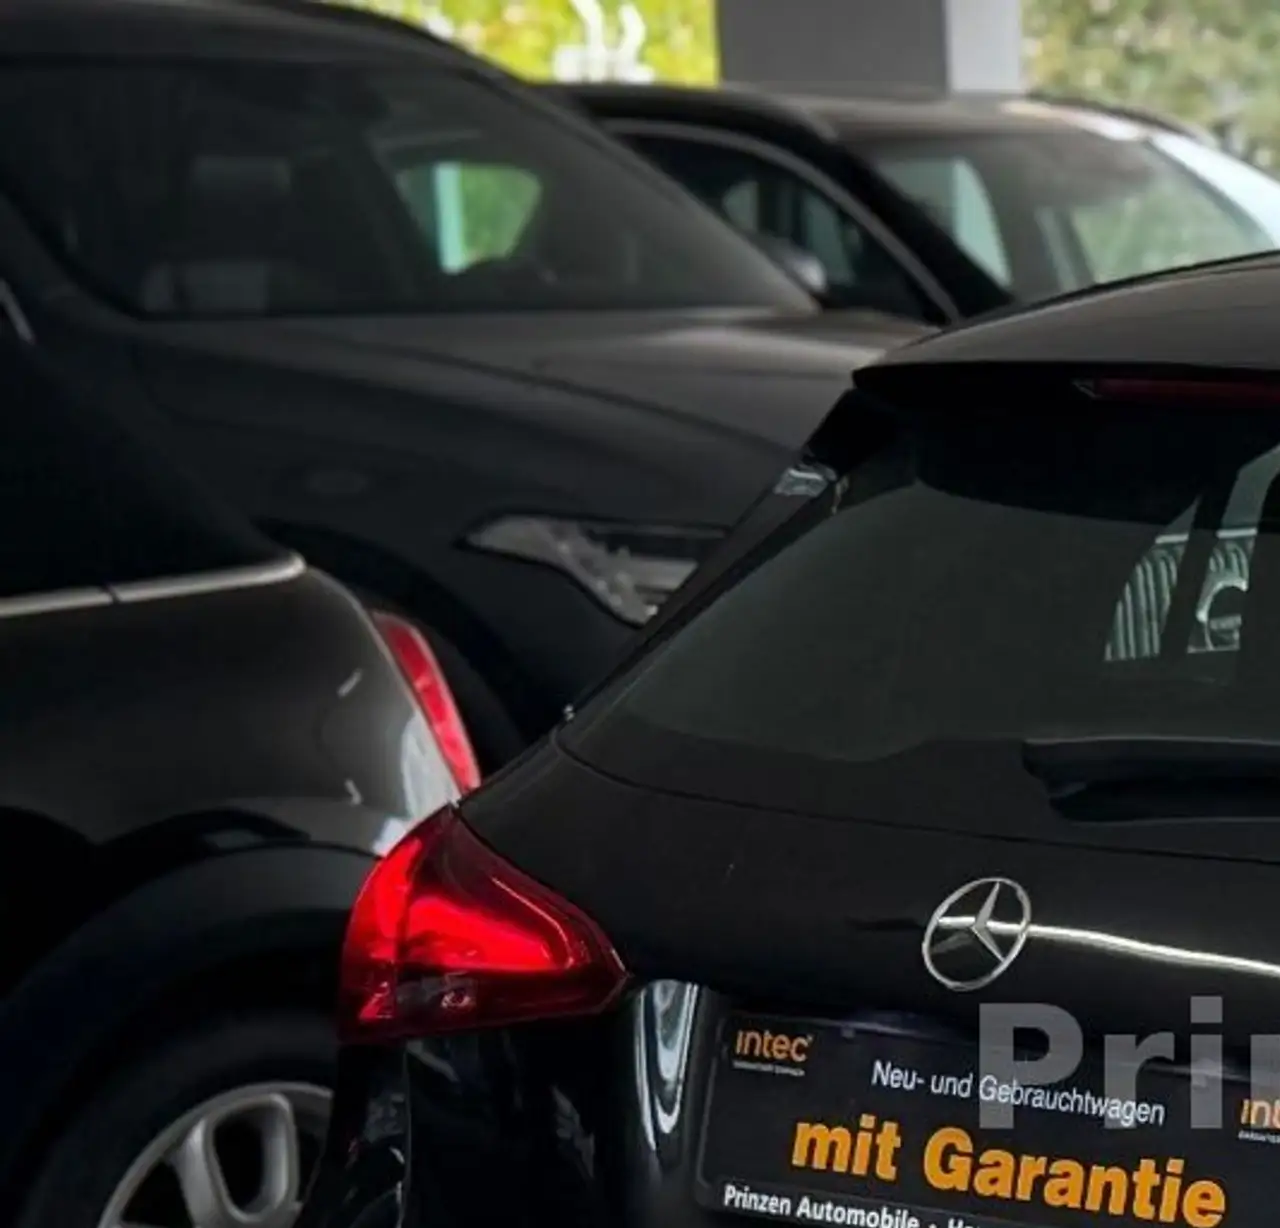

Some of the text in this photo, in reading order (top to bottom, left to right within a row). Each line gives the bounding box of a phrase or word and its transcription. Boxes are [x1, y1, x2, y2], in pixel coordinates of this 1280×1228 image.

[734, 1029, 810, 1062] intec
[872, 1060, 1166, 1127] Neu- und Gebrauchtwagen
[792, 1113, 1226, 1228] mit Garantie
[724, 1184, 791, 1215] Prinzen
